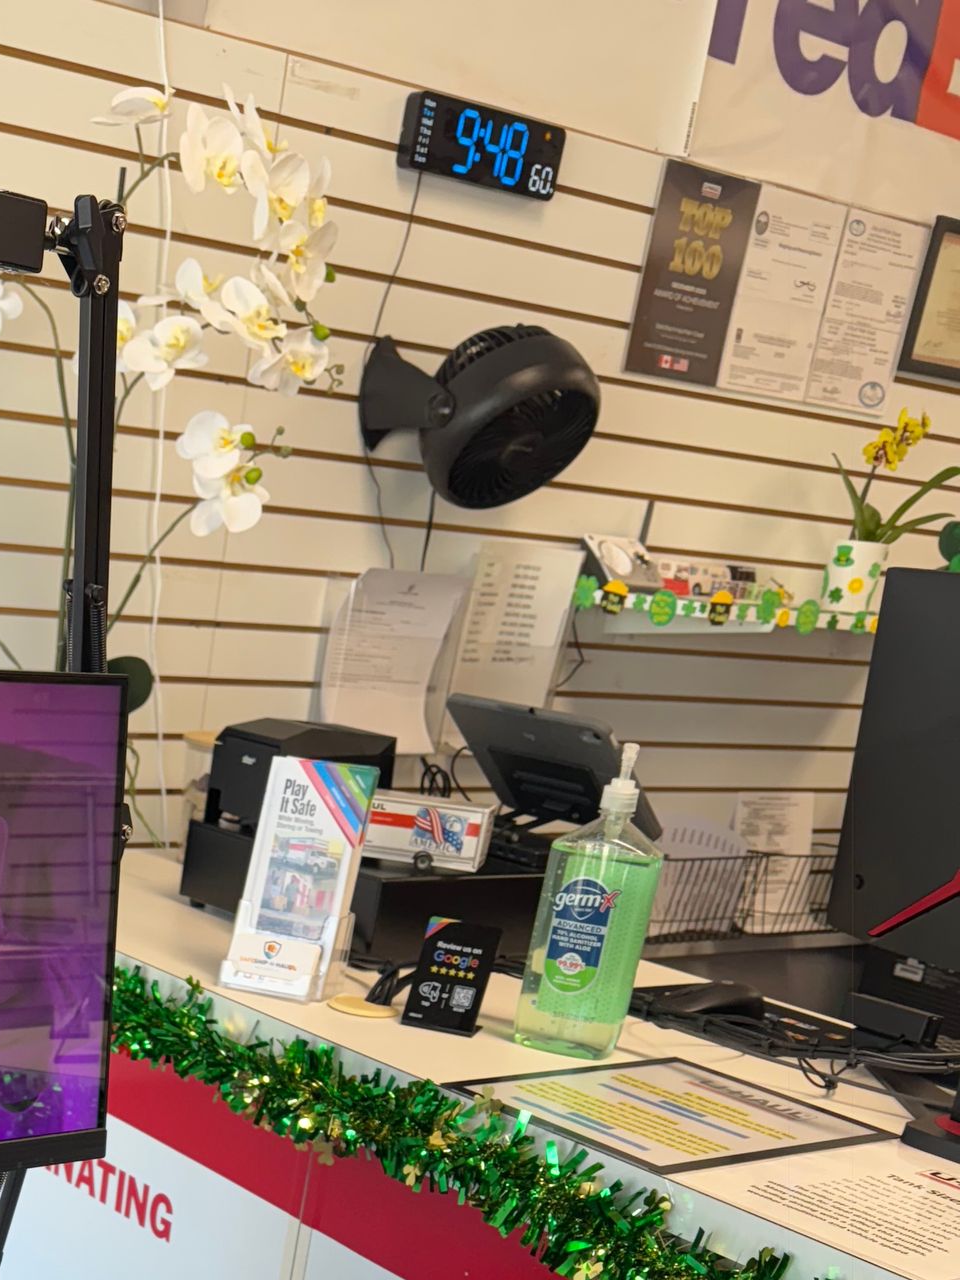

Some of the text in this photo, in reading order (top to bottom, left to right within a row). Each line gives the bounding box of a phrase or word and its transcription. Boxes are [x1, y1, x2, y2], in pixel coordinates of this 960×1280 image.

[452, 108, 530, 187] 9:48
[678, 197, 733, 240] TOP
[668, 236, 724, 281] 100
[283, 778, 309, 801] Play
[280, 796, 289, 814] It
[290, 797, 317, 817] Safe
[557, 920, 602, 933] ADVANCED
[436, 940, 462, 951] Review
[434, 950, 479, 969] Google
[45, 1158, 173, 1243] NATING
